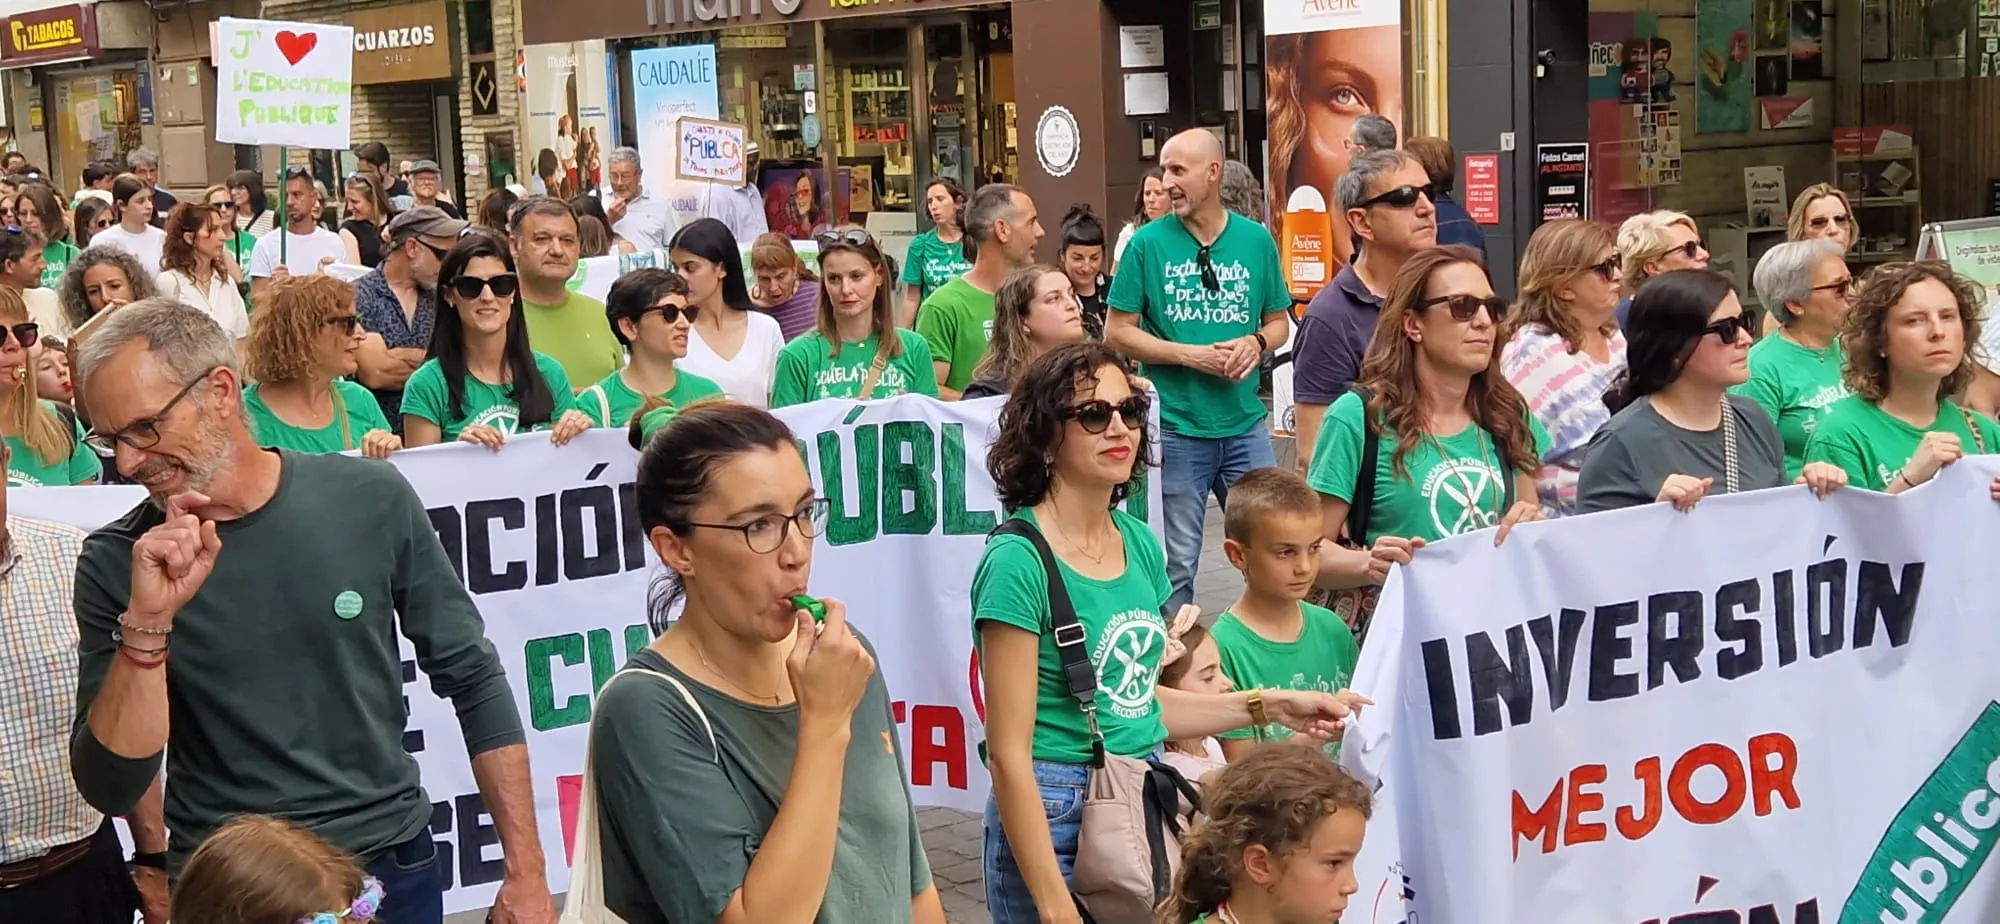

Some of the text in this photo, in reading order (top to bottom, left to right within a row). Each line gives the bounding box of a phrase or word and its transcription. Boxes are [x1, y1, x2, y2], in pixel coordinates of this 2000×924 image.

[27, 19, 75, 43] TABACOS
[354, 25, 434, 51] CUARZOS
[638, 53, 711, 87] CAUDALÍE
[689, 135, 740, 160] PÚBLCA
[1165, 261, 1203, 279] ESCUEL
[814, 364, 858, 386] SCUELA
[800, 404, 1003, 546] ÚBL
[1090, 612, 1128, 667] EDUCACIÓN
[1421, 533, 1926, 740] INVERSIÓN
[1510, 731, 1801, 863] MEJOR
